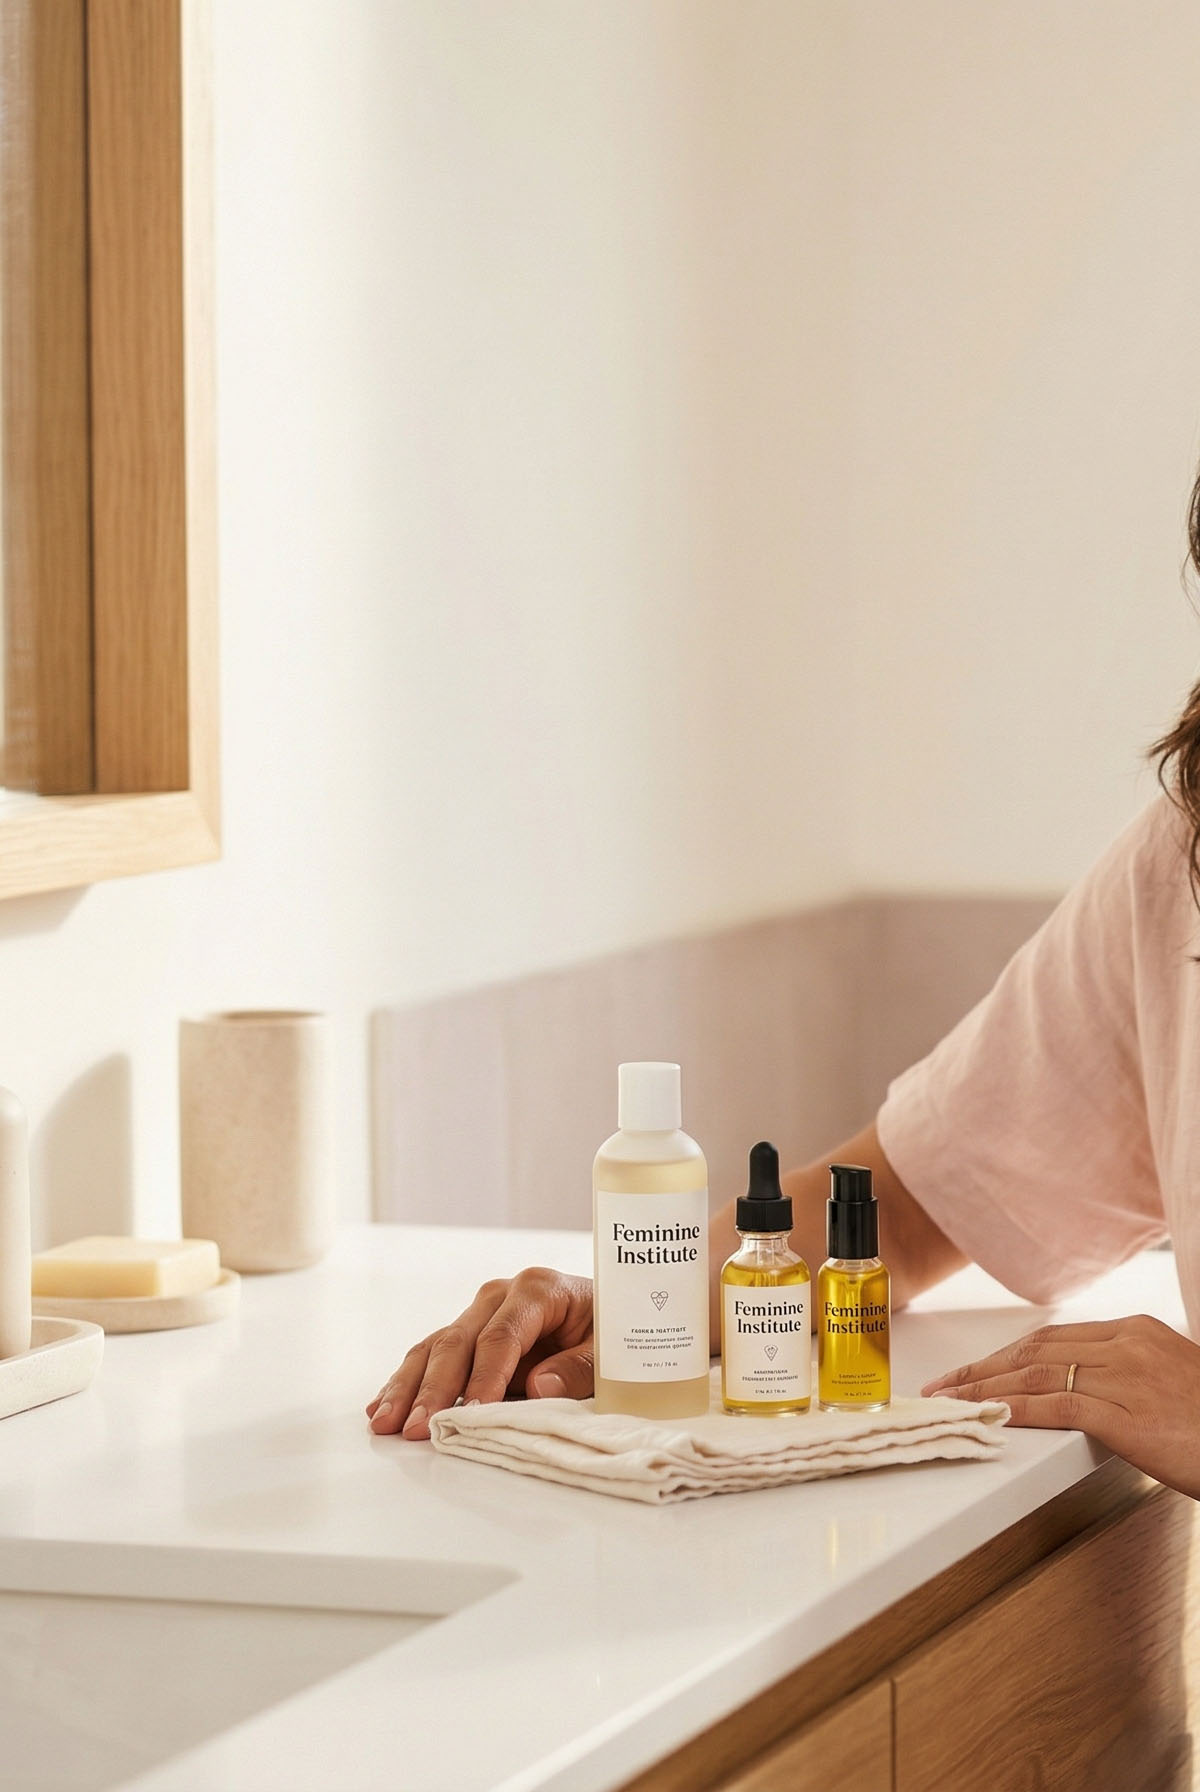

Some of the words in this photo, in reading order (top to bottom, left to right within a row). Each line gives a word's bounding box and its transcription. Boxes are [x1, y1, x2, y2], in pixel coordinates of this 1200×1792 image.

[613, 1223, 700, 1241] Feminine
[617, 1245, 697, 1264] Institute
[735, 1301, 804, 1316] Feminine
[825, 1302, 887, 1317] Feminine
[738, 1319, 801, 1333] Institute
[827, 1319, 886, 1333] Institute
